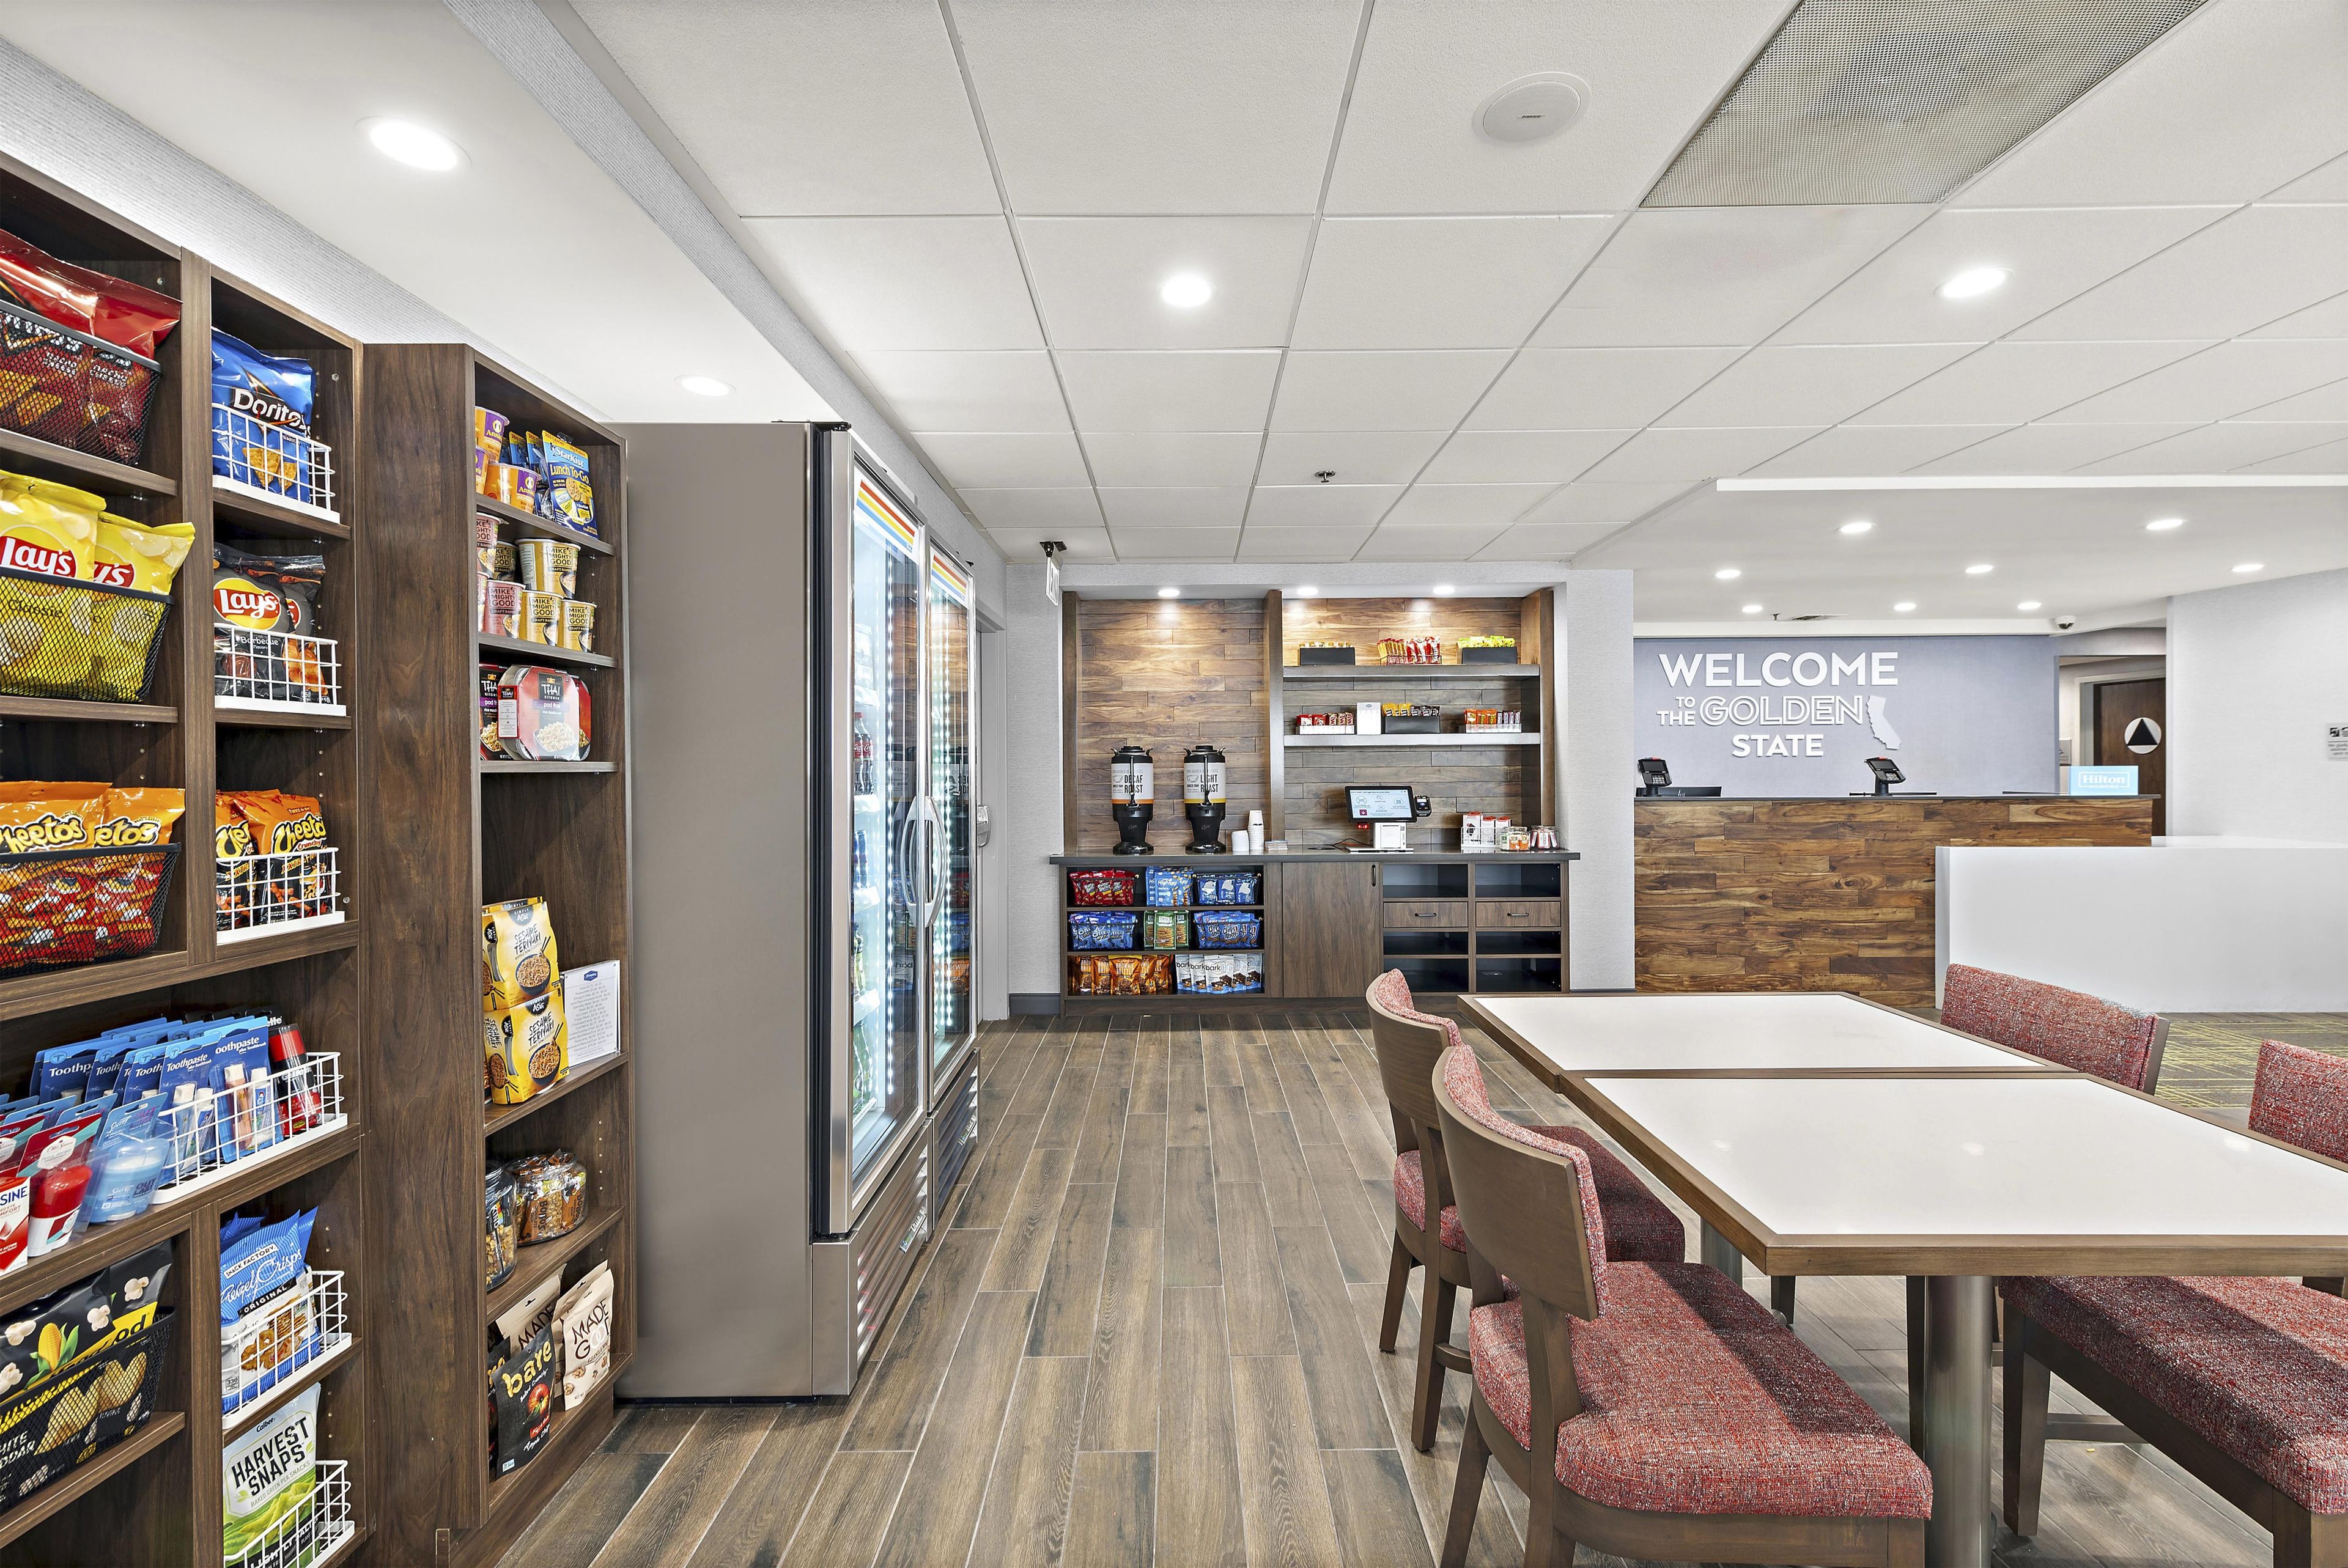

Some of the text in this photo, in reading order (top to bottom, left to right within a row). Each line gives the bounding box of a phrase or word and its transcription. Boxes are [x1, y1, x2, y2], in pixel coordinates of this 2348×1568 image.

[556, 447, 584, 467] StarKist
[550, 464, 570, 476] Lunch
[549, 546, 572, 554] MIKE'S
[491, 587, 516, 595] MIKE'S
[219, 589, 278, 620] Lay's
[1658, 651, 1899, 687] WELCOME
[541, 683, 561, 696] THAI
[1656, 695, 1863, 726] THE GOLDEN
[1675, 696, 1696, 708] TO
[1732, 734, 1825, 757] STATE
[1200, 774, 1218, 783] LGHT
[1200, 784, 1219, 793] RAST
[2083, 775, 2125, 784] Hilton
[0, 815, 85, 853] heetos
[298, 840, 322, 850] Crunchy
[514, 924, 537, 945] SESAME
[514, 931, 541, 955] TERIYAKI
[528, 1020, 555, 1047] TERIYAKI
[530, 1012, 552, 1035] SESAME
[166, 1053, 208, 1073] Toothpaste
[136, 1179, 157, 1190] OUT
[226, 1262, 243, 1277] SNACK
[256, 1249, 303, 1283] Crisps
[243, 1285, 287, 1313] ORIGINAL
[572, 1297, 609, 1345] MADE
[502, 1339, 552, 1398] bare
[256, 1417, 274, 1432] Calbee
[231, 1416, 309, 1489] HARVEST
[248, 1444, 305, 1496] SNAPS
[251, 1460, 311, 1507] BAKED GREEN PEA SNACKS
